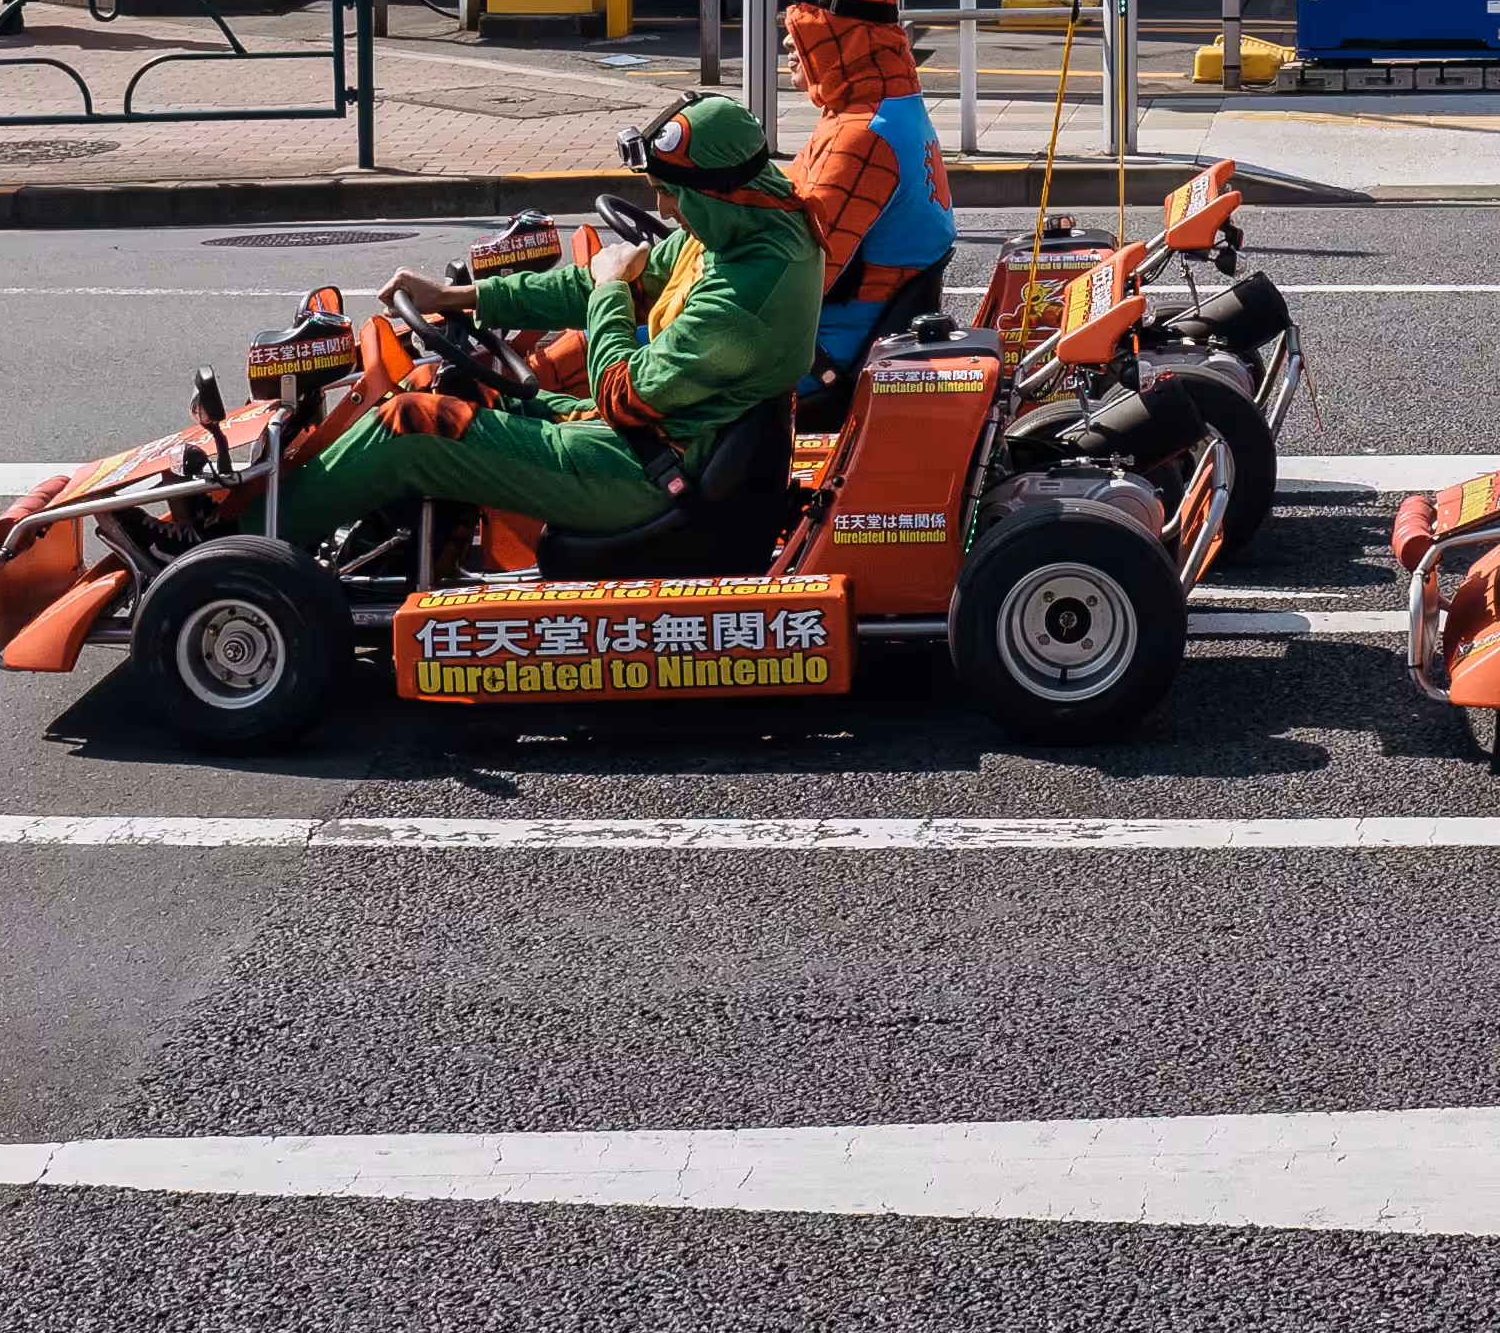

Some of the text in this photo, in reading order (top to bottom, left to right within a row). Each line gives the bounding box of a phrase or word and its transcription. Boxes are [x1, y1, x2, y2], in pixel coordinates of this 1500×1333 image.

[873, 369, 984, 384] 任天堂は無関係
[833, 513, 947, 531] 任天堂は無関係
[415, 609, 827, 659] 任天堂は無関係
[416, 652, 828, 695] Unrelated to Nintendo
